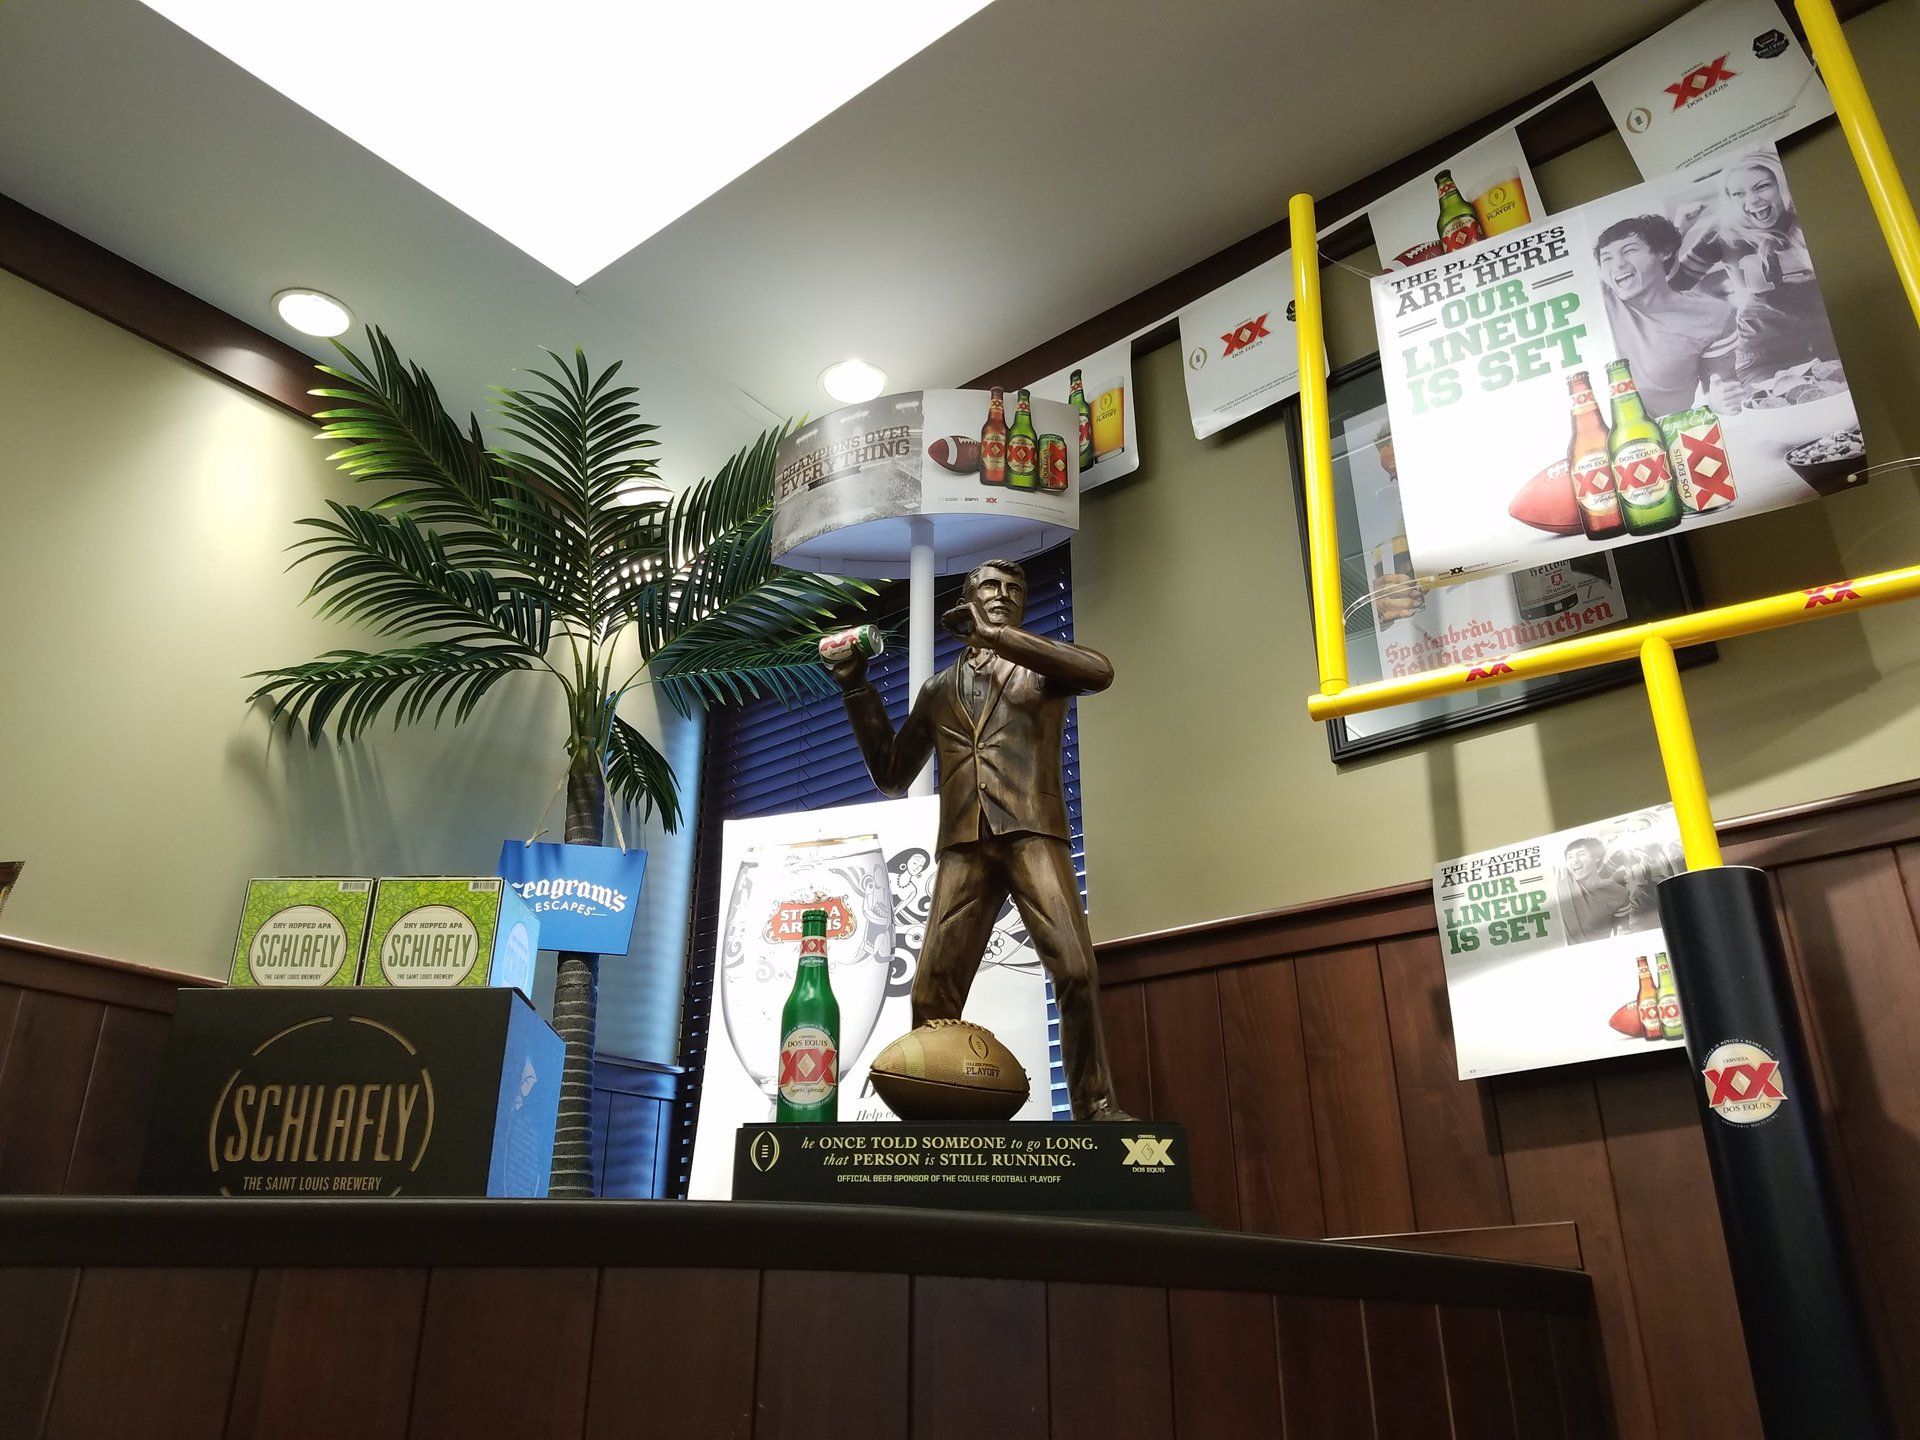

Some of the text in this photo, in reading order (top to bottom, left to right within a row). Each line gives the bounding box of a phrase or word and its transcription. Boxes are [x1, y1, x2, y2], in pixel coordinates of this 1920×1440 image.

[1663, 54, 1738, 111] XX
[1686, 82, 1729, 109] DOS EQUIS
[1486, 202, 1517, 221] PLAYOFF
[1391, 226, 1565, 294] THE PLAYOFFS
[1395, 238, 1570, 318] ARE HERE
[1441, 278, 1530, 329] OUR
[1220, 312, 1271, 357] XX
[1402, 292, 1581, 379] LINEUP
[1407, 323, 1588, 415] IS SET
[781, 439, 910, 499] EVERYTHING
[782, 425, 911, 481] CHAMPIONS OVER
[1619, 453, 1635, 463] DOS
[1636, 449, 1659, 460] EQUIS
[1674, 448, 1687, 477] EQUIS
[1677, 421, 1737, 511] XX
[1613, 452, 1673, 493] XX
[1681, 479, 1692, 499] DOS
[1449, 566, 1464, 576] XX
[1385, 619, 1495, 665] Spatenbräu
[1441, 846, 1540, 876] THE PLAYOFFS
[1441, 855, 1542, 888] ARE HERE
[1467, 876, 1518, 901] OUR
[535, 900, 593, 916] ESCAPES
[1444, 890, 1547, 930] LINEUP
[779, 919, 842, 934] ARIS
[1448, 911, 1551, 955] IS SET
[256, 933, 341, 968] SCHLAFLY
[388, 933, 473, 968] SCHLAFLY
[788, 1040, 803, 1048] DOS
[779, 1048, 837, 1087] XX
[965, 1066, 1001, 1077] PLAYOFF
[1701, 1060, 1789, 1109] XX
[223, 1083, 421, 1163] SCHLAFLY
[855, 1108, 883, 1122] Help
[1723, 1101, 1772, 1114] DOS EQUIS
[801, 1136, 1098, 1153] he ONCE TOLD SOMEONE to go LONG.
[823, 1153, 1076, 1167] that PERSON is STILL RUNNING.
[1120, 1137, 1175, 1166] XX
[243, 1176, 382, 1191] THE SAINT LOUIS BREWERY
[837, 1174, 1062, 1183] OFFICIAL BEER SPONSOR OF THE COLLEGE FOOTBALL PLAYOFF
